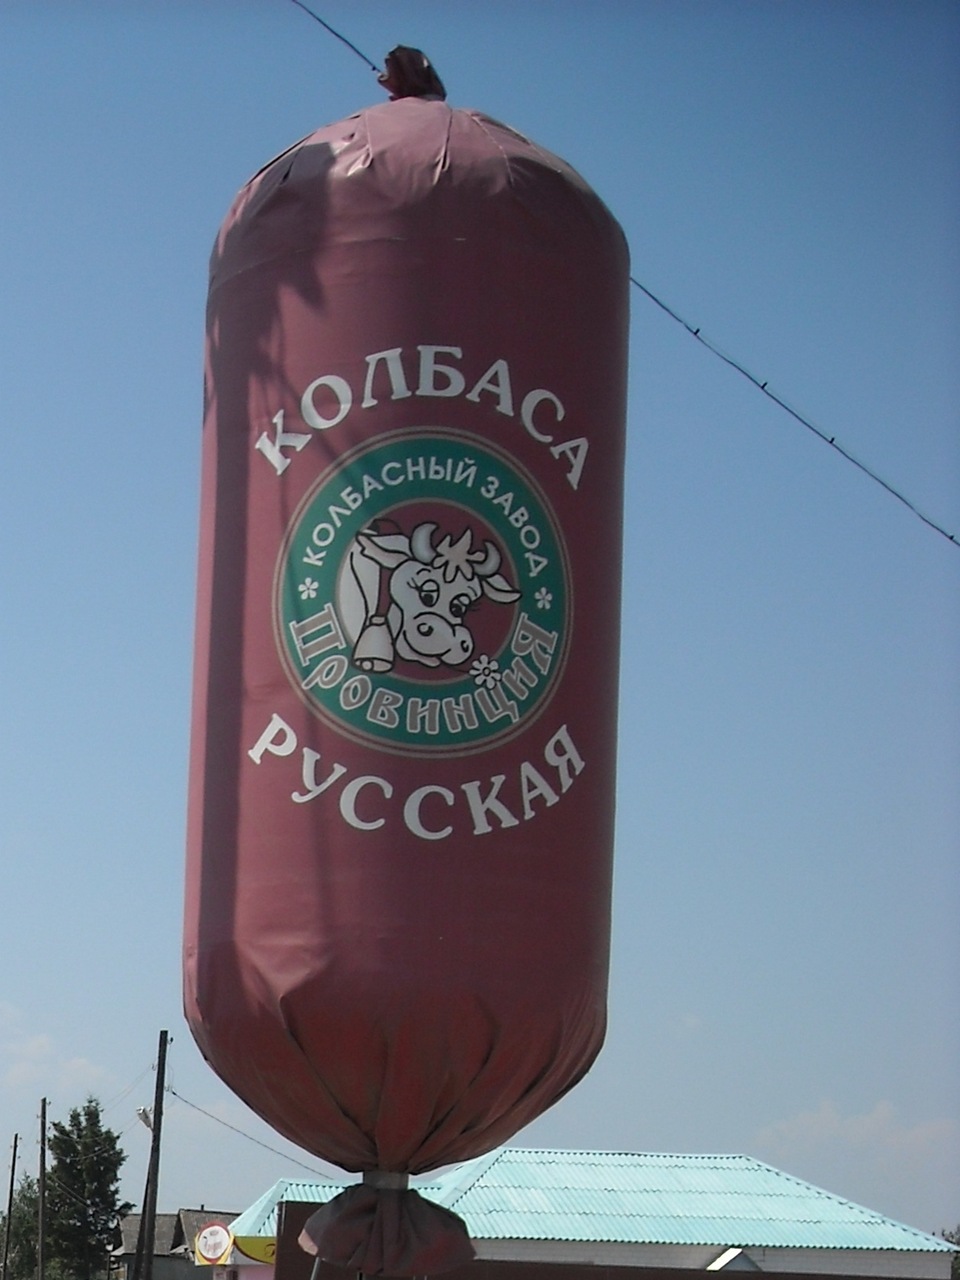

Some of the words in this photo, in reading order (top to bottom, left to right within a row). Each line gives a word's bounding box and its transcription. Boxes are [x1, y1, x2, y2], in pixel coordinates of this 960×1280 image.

[255, 345, 590, 489] КОЛБАСА
[304, 457, 476, 566] КОЛБАСНЫЙ
[481, 477, 548, 577] ЗАВОД
[247, 713, 586, 840] РУССКАЯ
